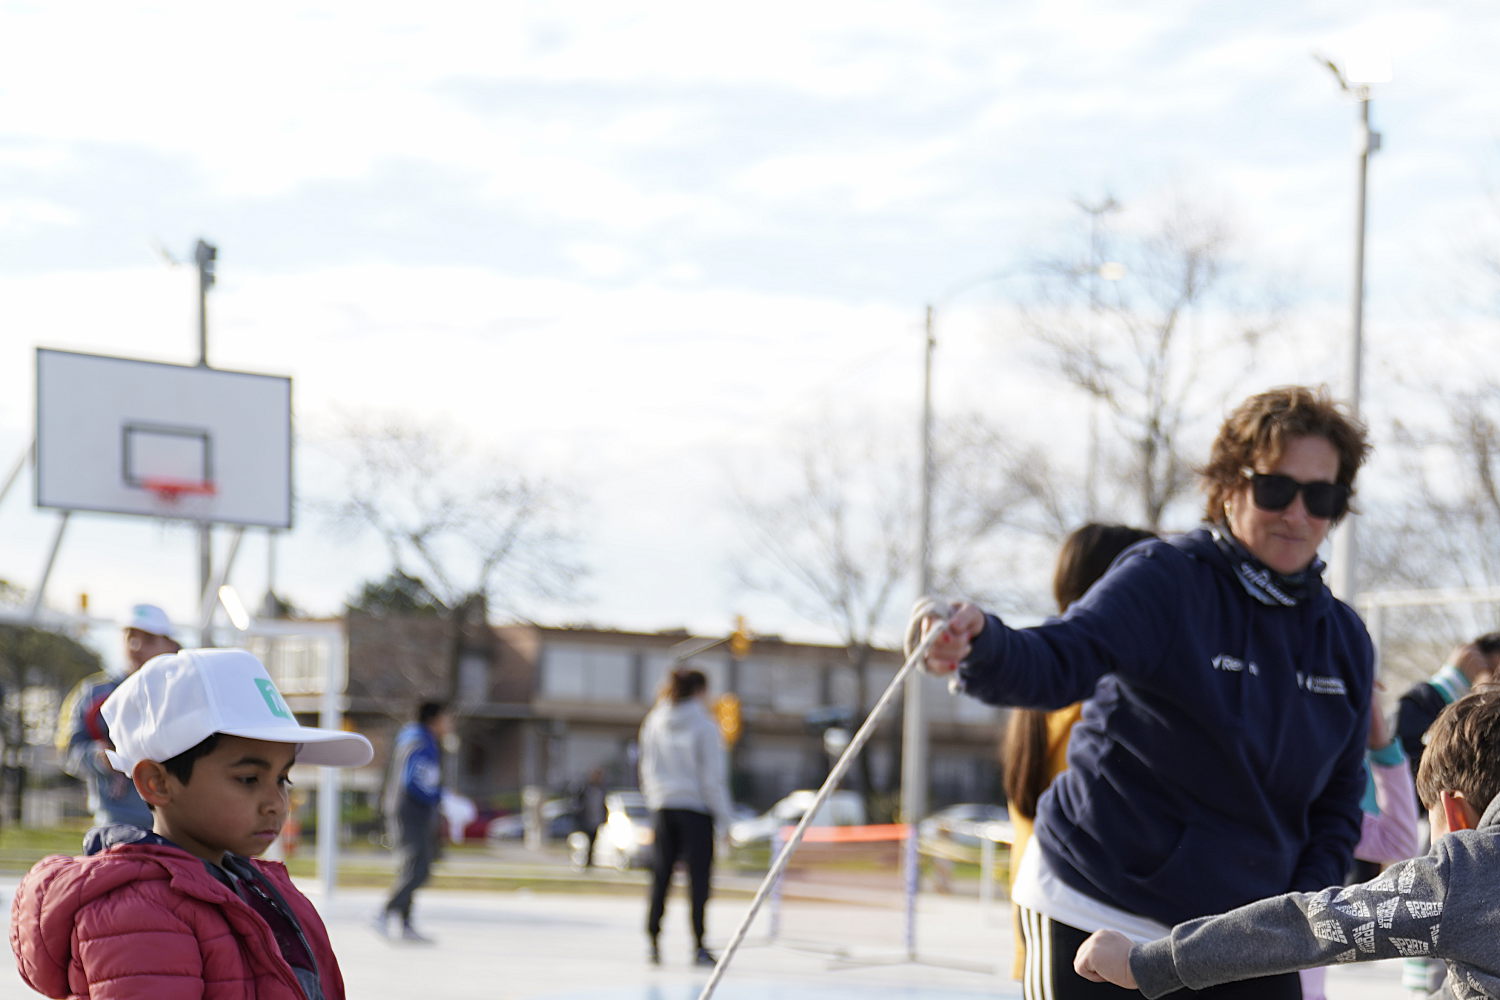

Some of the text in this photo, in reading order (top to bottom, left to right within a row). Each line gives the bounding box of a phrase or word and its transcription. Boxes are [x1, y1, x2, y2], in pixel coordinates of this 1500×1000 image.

[1383, 896, 1400, 929] SPORTS
[1405, 900, 1443, 914] SPORTS
[1358, 921, 1375, 954] SPORTS
[1388, 937, 1429, 951] SPORTS
